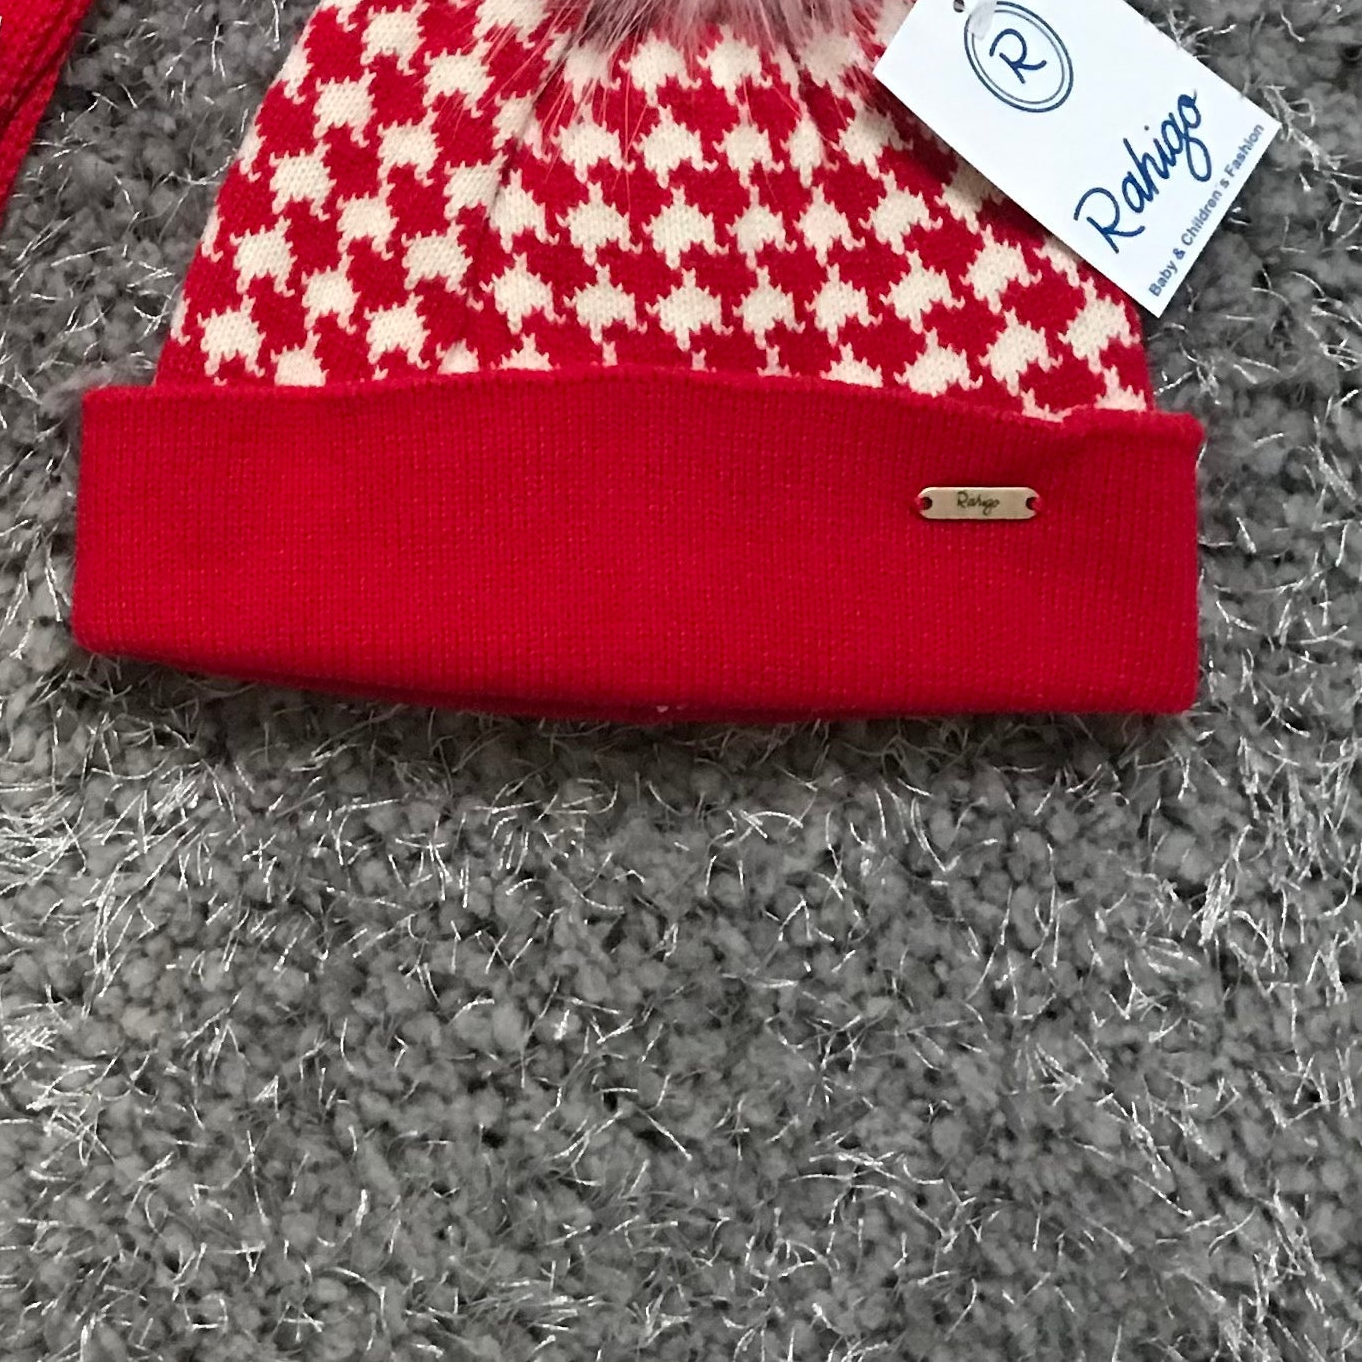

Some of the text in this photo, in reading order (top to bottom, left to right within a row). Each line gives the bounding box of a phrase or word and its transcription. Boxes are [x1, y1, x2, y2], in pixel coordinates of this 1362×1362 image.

[989, 28, 1048, 84] R
[1073, 88, 1213, 254] Rahigo
[1148, 260, 1179, 297] Baby
[1172, 247, 1186, 261] &
[1224, 124, 1265, 178] Fashion
